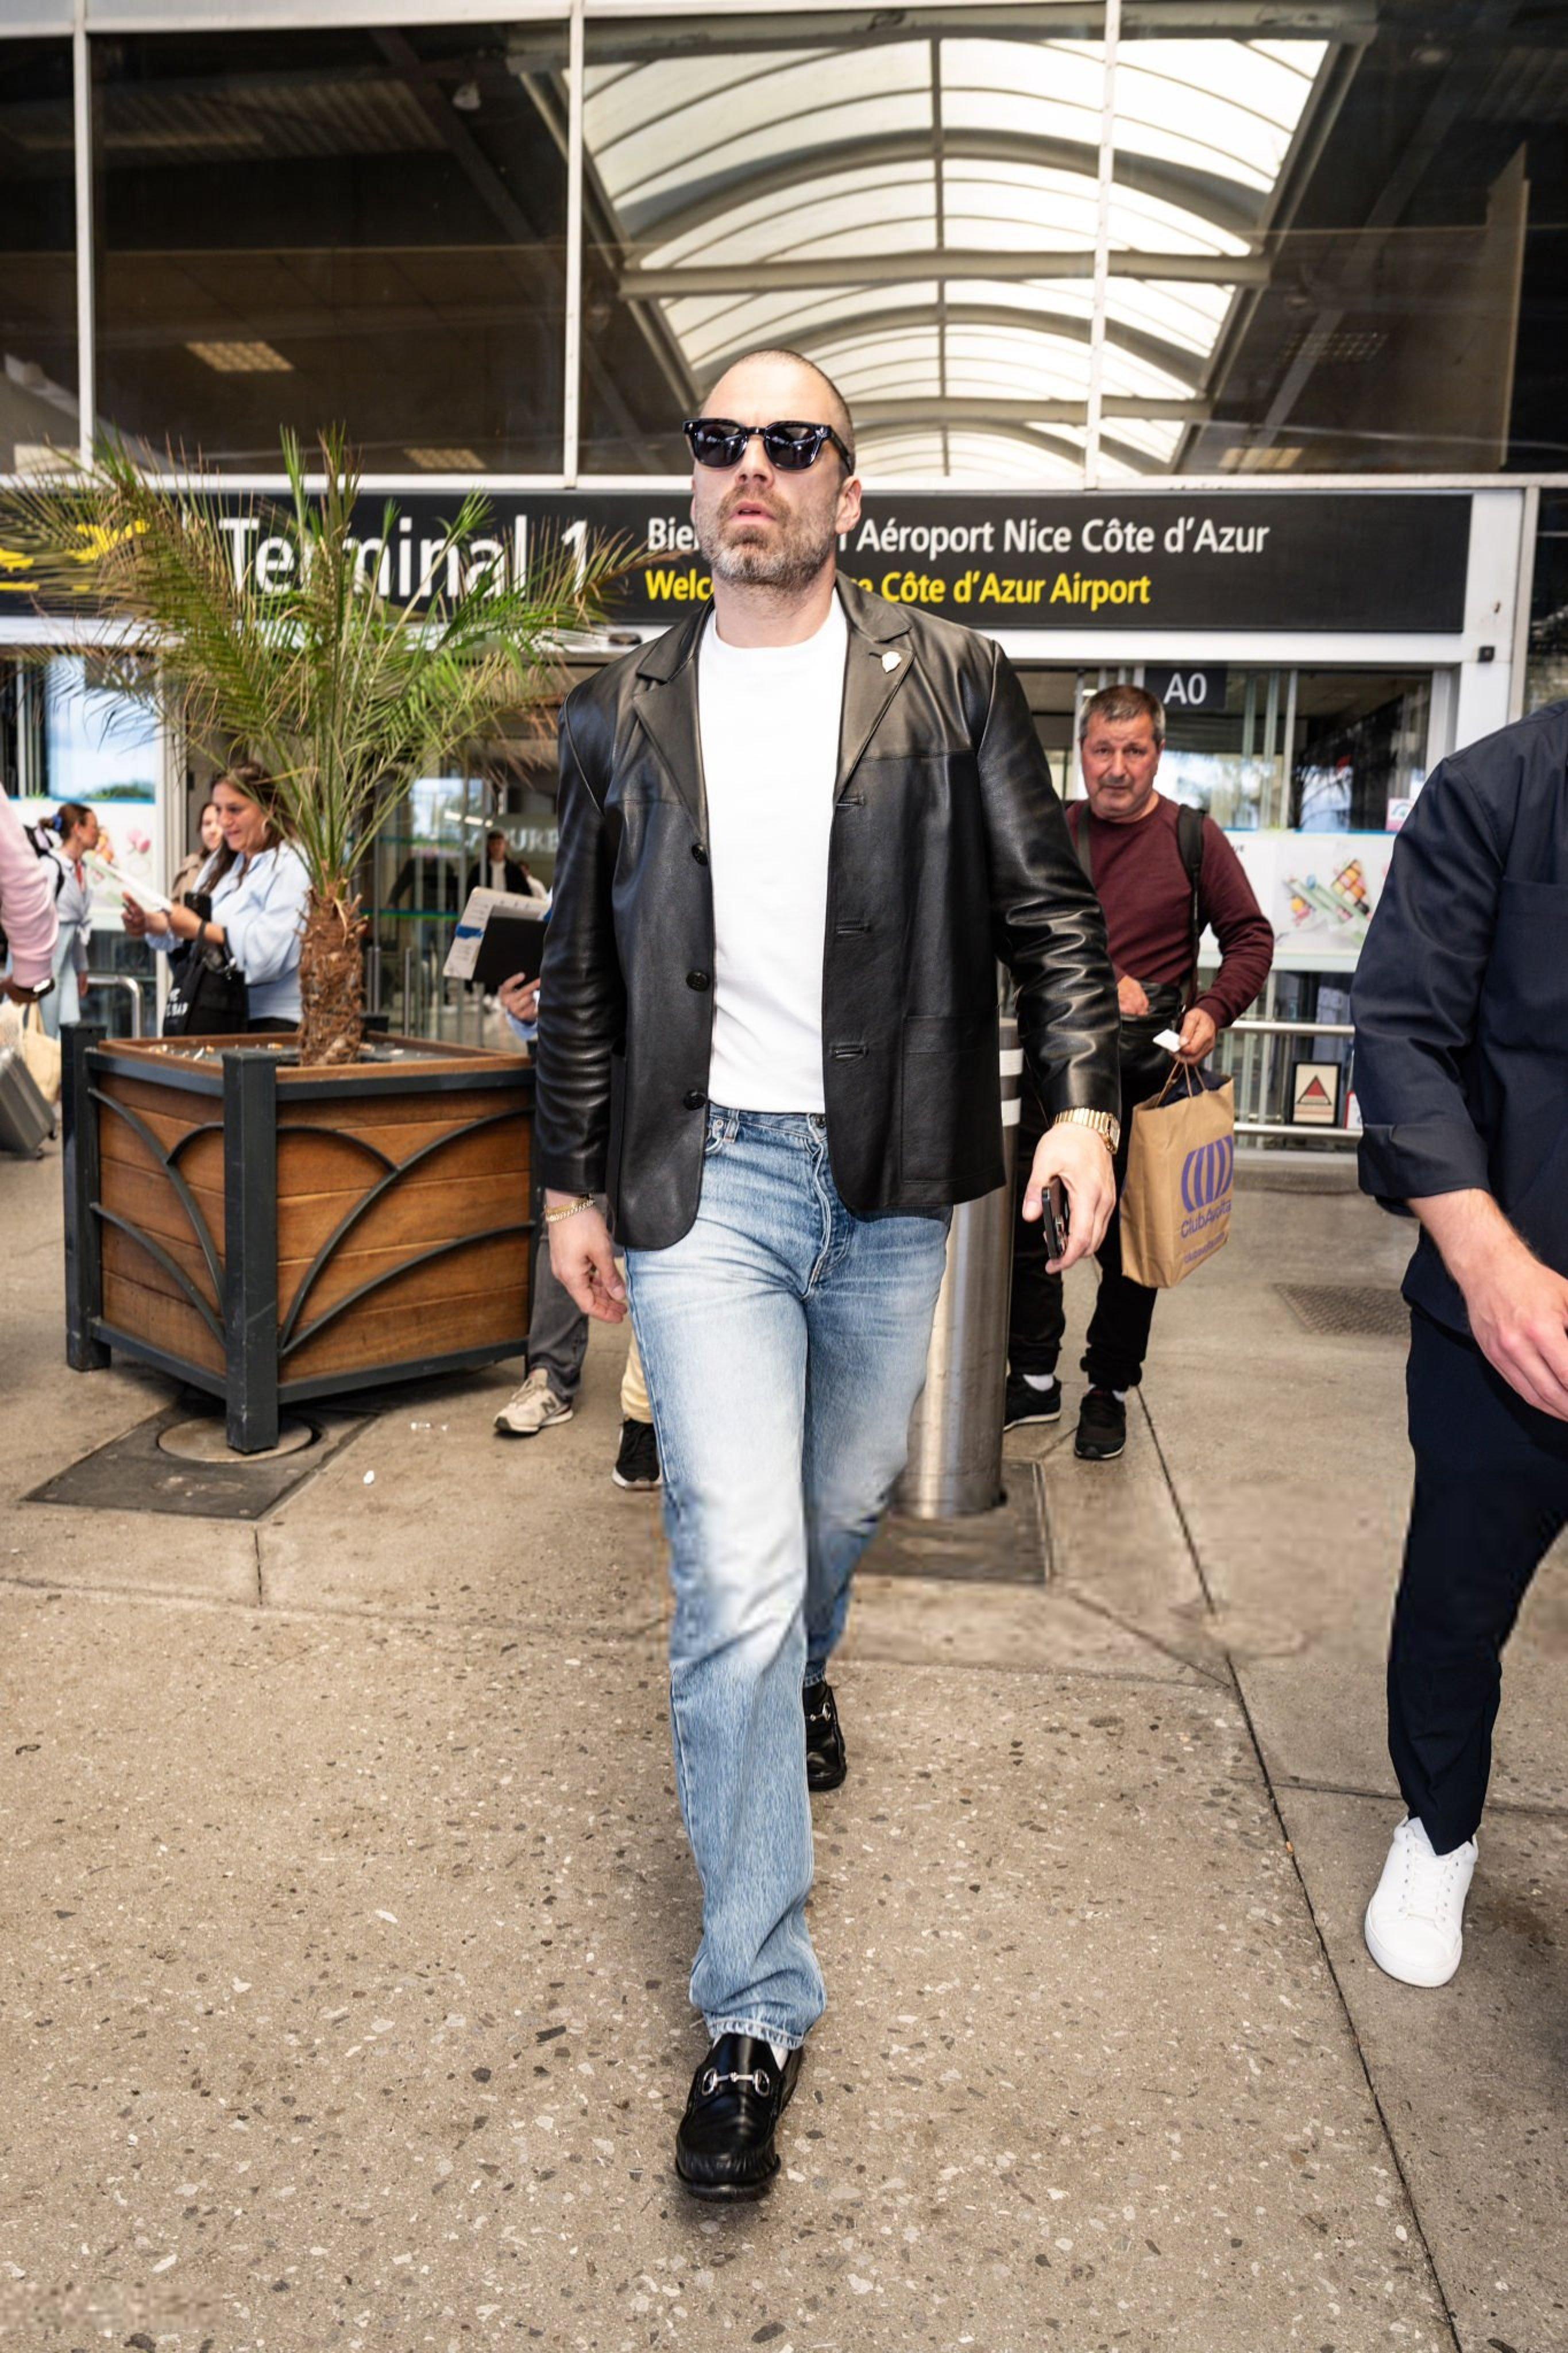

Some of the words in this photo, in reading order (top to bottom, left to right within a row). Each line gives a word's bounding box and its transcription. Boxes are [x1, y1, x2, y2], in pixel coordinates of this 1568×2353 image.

[561, 519, 588, 596] 1
[856, 518, 995, 561] Aéroport
[1003, 518, 1072, 553] Nice
[1082, 518, 1155, 553] Côte
[1164, 516, 1270, 553] d’Azur
[644, 568, 715, 601] Welc
[881, 571, 947, 603] Côte
[953, 570, 1046, 603] d’Azur
[1050, 572, 1151, 611] Airport
[1163, 672, 1207, 705] A0
